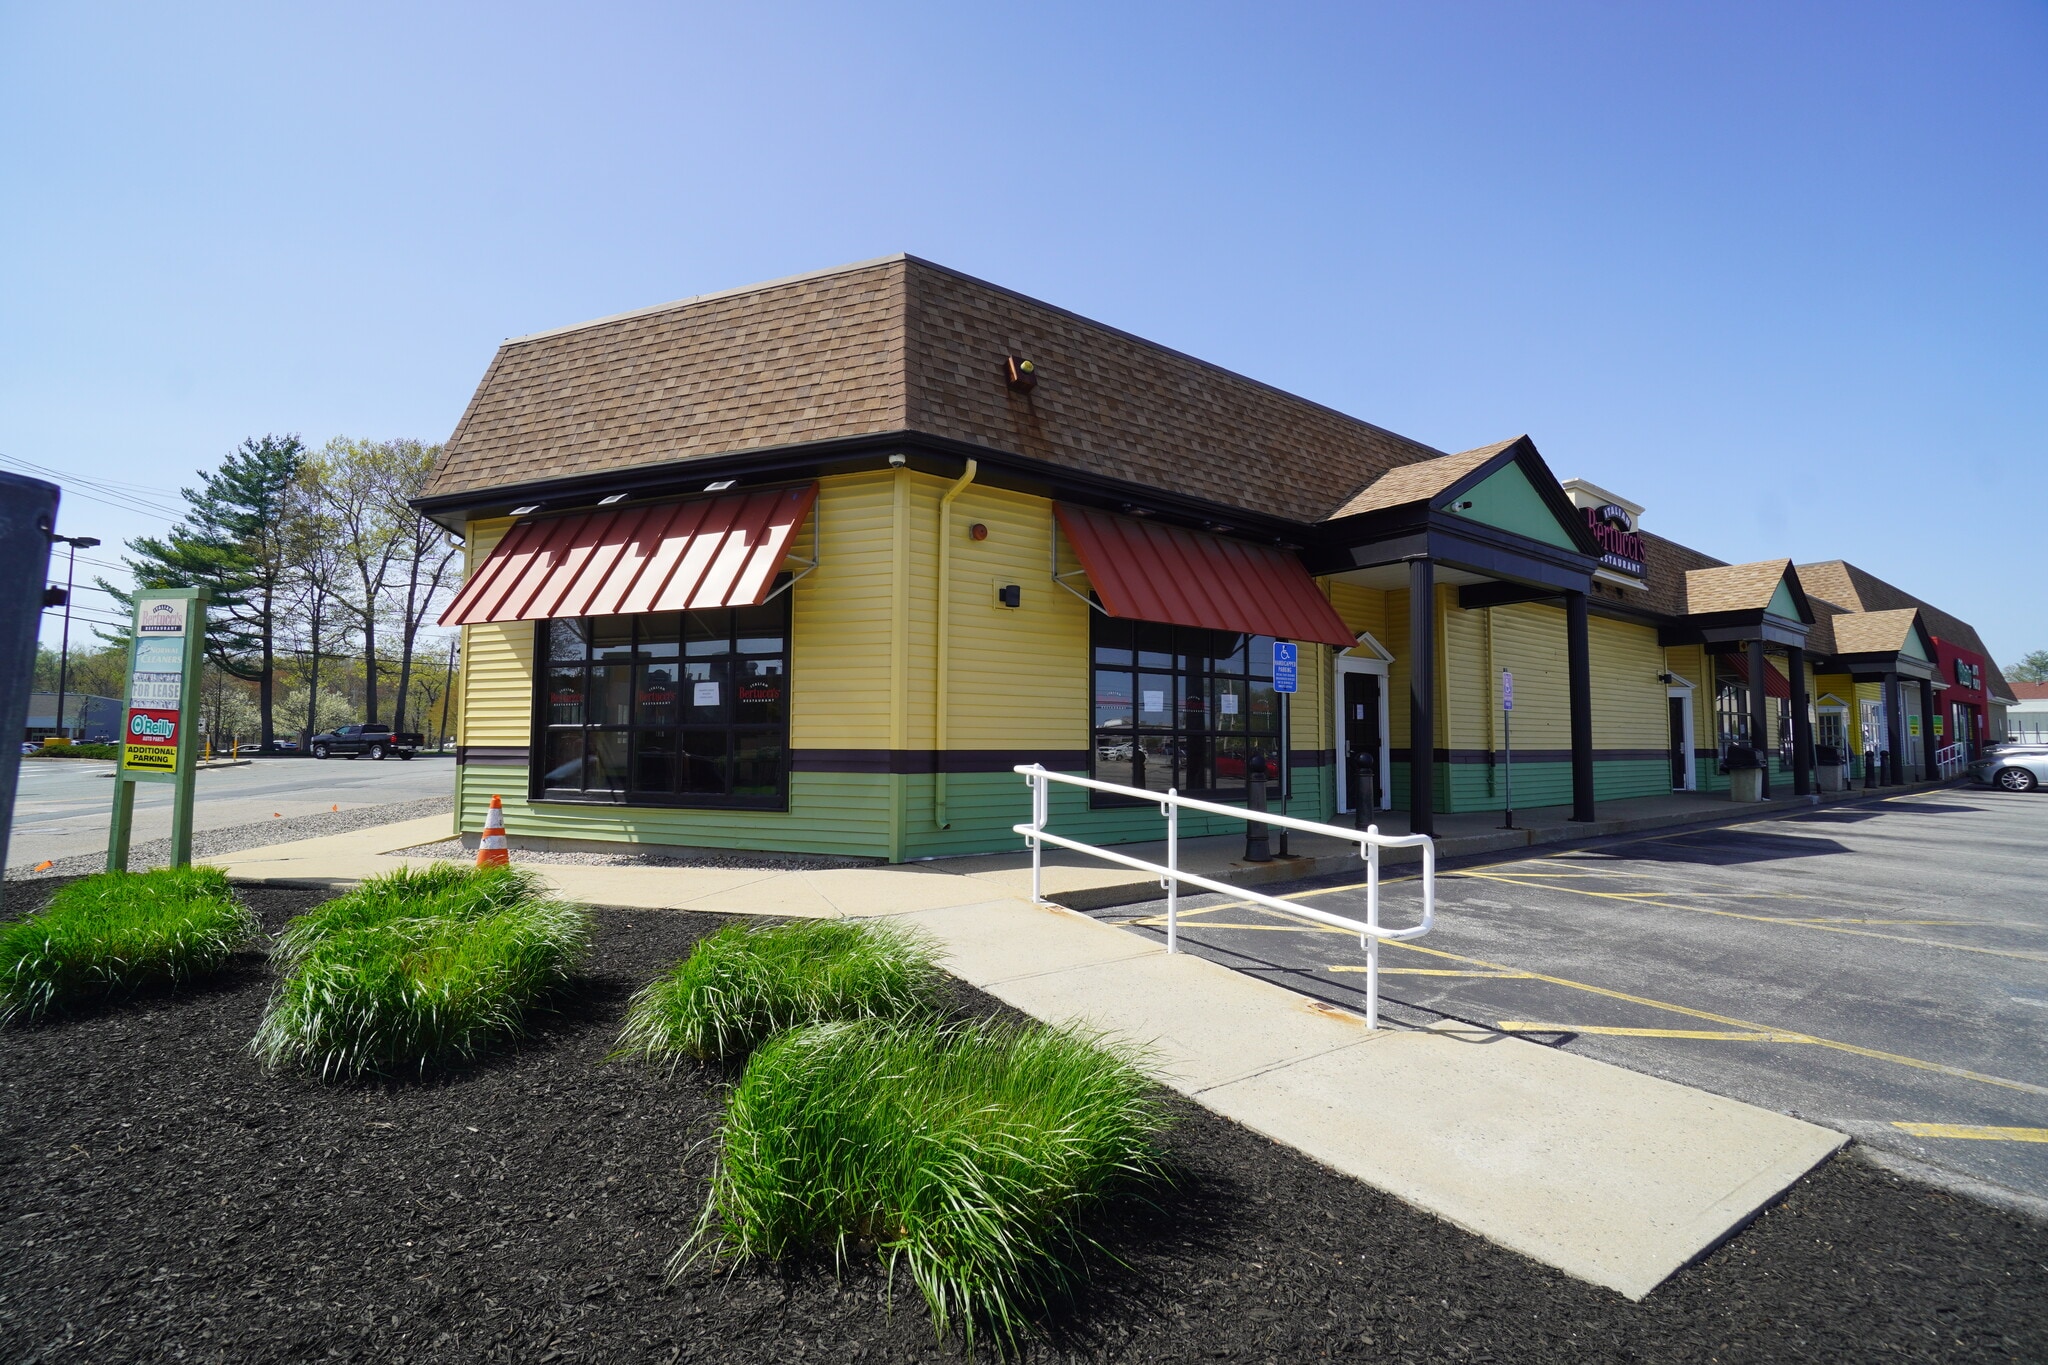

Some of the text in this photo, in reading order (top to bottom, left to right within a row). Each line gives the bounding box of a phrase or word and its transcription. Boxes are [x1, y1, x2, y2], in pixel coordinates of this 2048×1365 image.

[1603, 507, 1631, 526] ITALIAN
[1587, 508, 1645, 562] Bertucci's
[1600, 554, 1641, 574] STAURANT
[153, 604, 173, 613] ITALIAN
[143, 611, 183, 625] Bertucci's
[141, 655, 182, 664] CLEANERS
[133, 683, 180, 698] FOR LEASE
[131, 714, 175, 738] O'Reilly
[128, 747, 175, 755] ADDITIONAL
